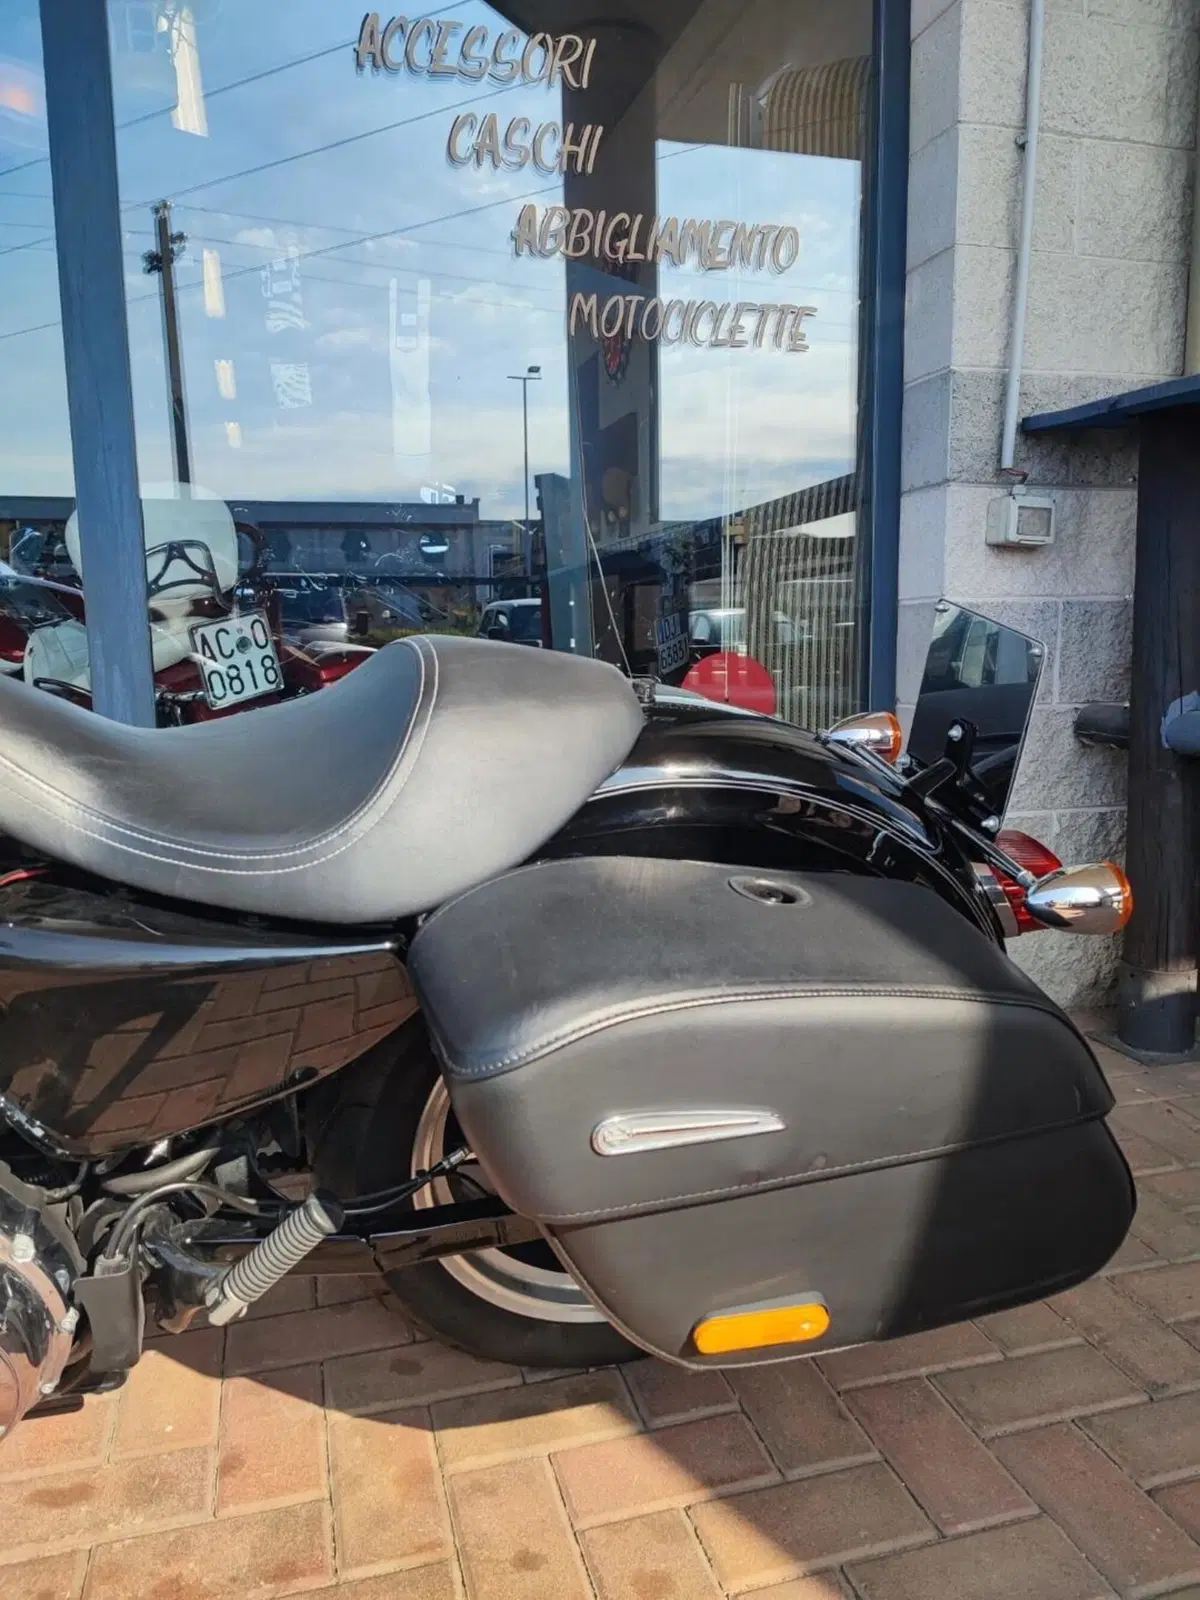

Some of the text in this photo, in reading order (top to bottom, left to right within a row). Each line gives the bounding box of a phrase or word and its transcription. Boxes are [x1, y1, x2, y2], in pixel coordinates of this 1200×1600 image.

[354, 12, 597, 90] ACCESSORI
[446, 113, 603, 175] CASCHI
[511, 204, 799, 273] ABBIGLIAMENTO
[569, 292, 817, 353] MOTOCICLETTE
[200, 628, 235, 662] AC
[208, 655, 278, 700] 0818
